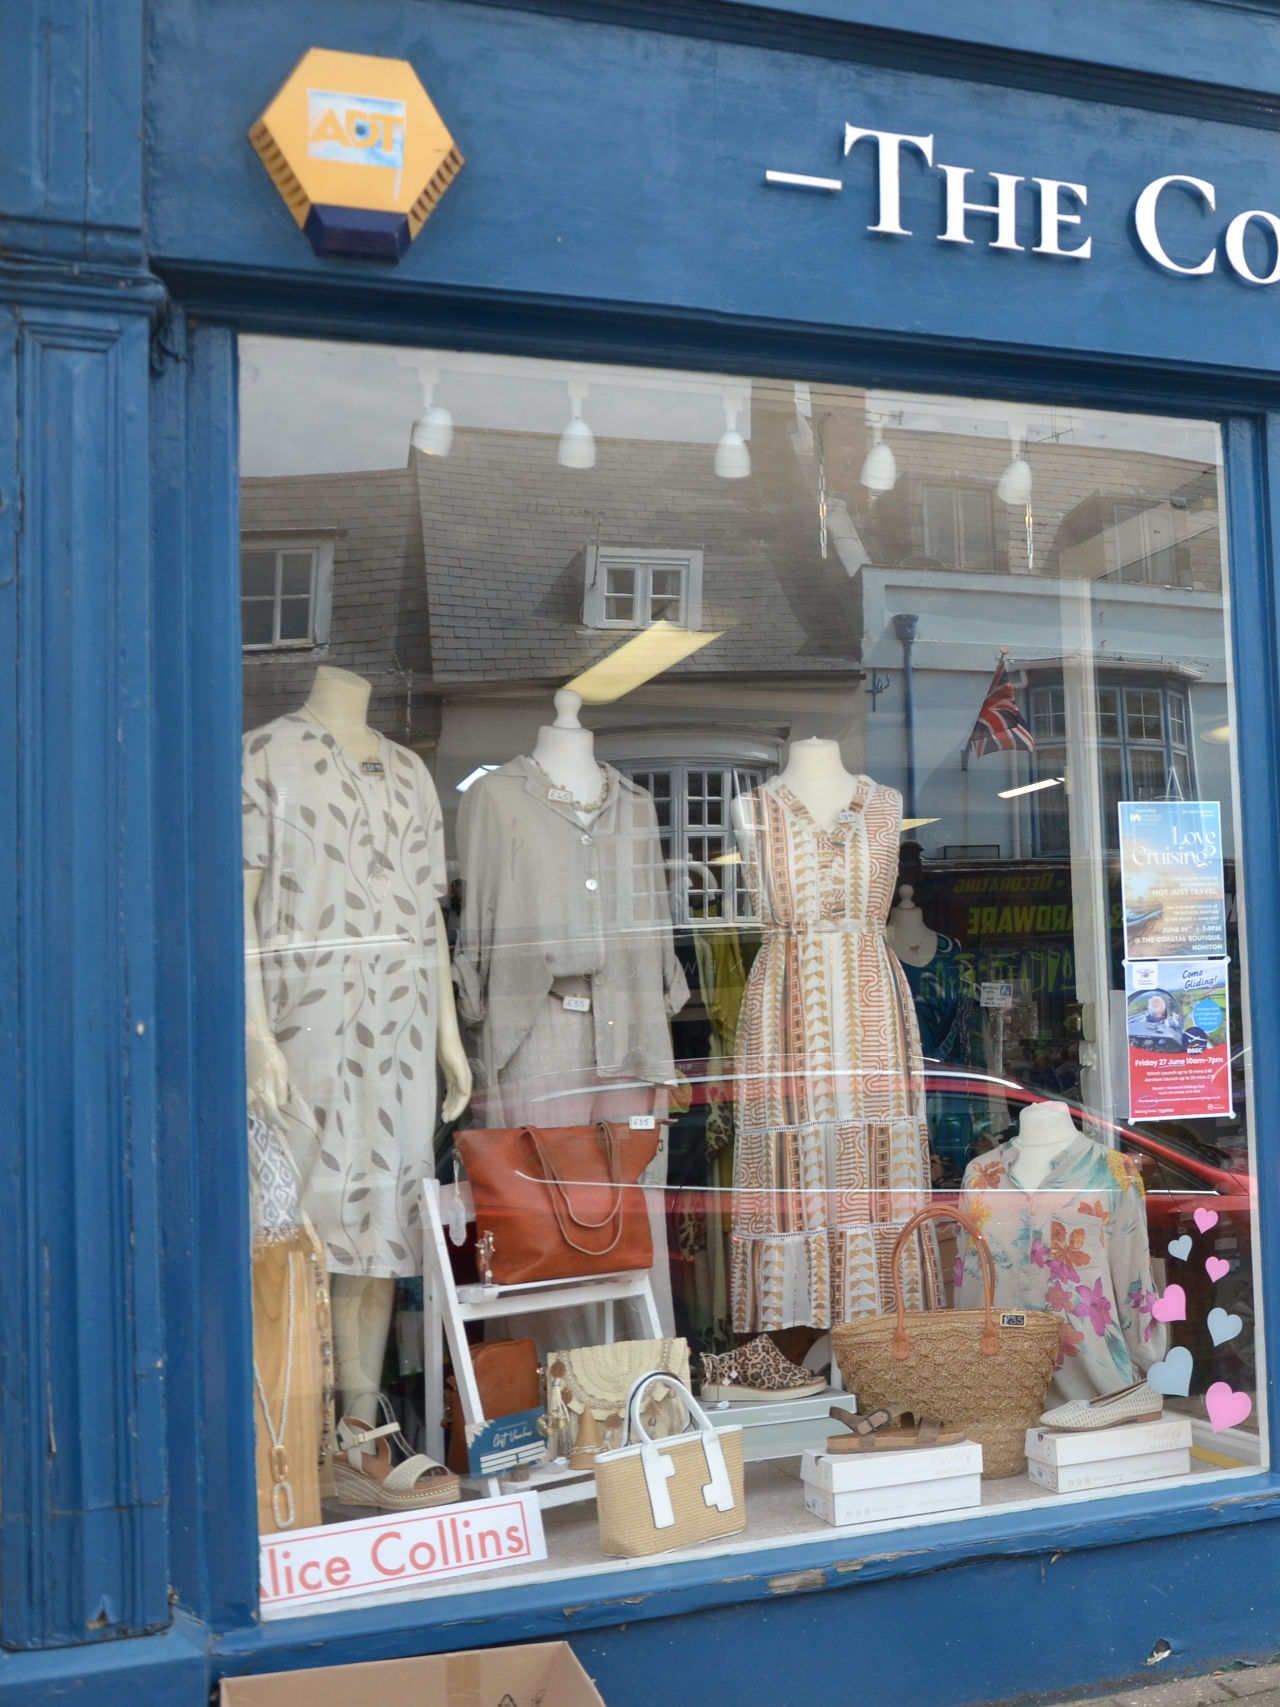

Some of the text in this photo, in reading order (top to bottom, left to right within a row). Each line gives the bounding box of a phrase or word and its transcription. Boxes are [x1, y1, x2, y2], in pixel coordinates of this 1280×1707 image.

[308, 104, 404, 154] ADT
[844, 121, 1092, 259] THE
[1172, 825, 1216, 845] Love
[1131, 845, 1217, 868] Cruising?
[1182, 969, 1204, 979] Come
[1184, 975, 1218, 989] Gliding!
[1134, 1059, 1159, 1068] Friday
[260, 1517, 524, 1598] lice Collins
